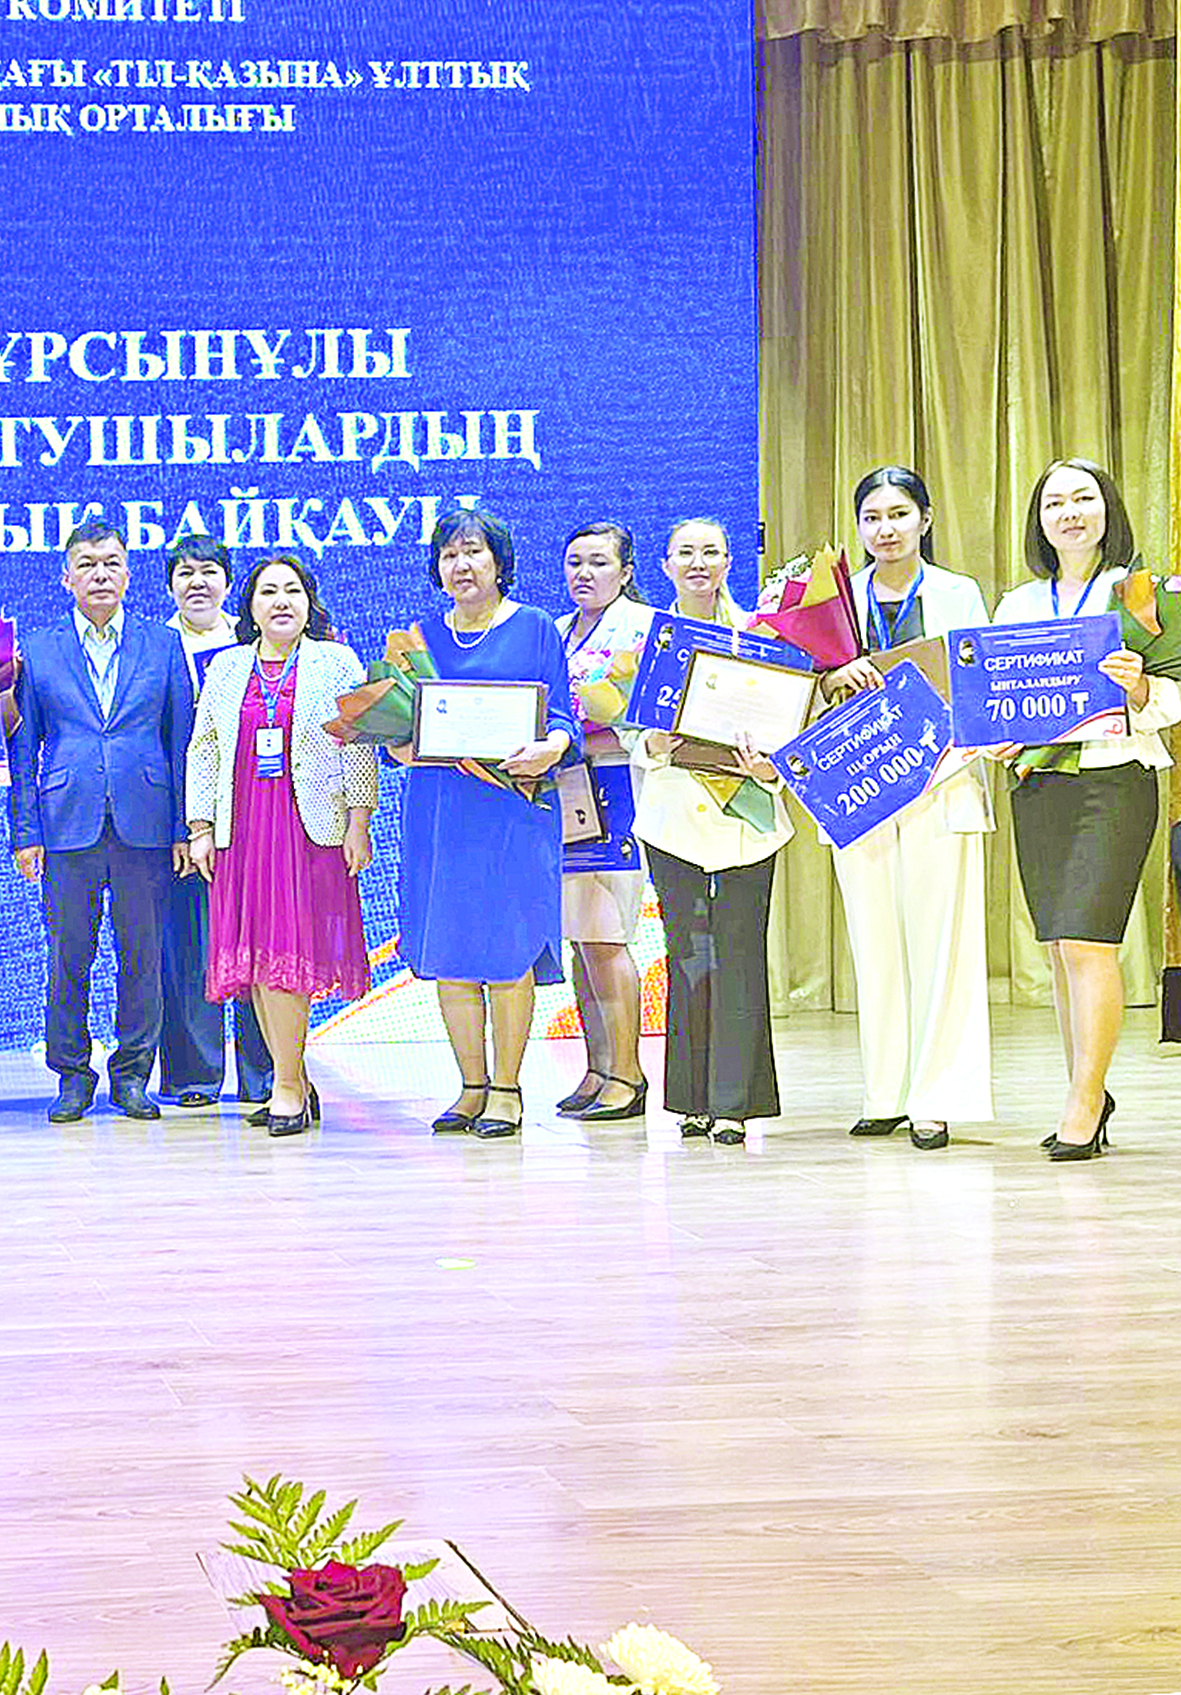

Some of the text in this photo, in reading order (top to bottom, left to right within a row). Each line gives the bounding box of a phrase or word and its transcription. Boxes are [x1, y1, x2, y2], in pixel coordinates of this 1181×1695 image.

[368, 61, 530, 92] ҰЛТТЫҚ
[79, 104, 296, 132] ОРТАЛЫҒЫ
[984, 649, 1085, 672] СЕРТИФИКАТ
[985, 697, 1017, 722] 70
[1022, 693, 1067, 719] 000
[817, 703, 904, 772] СЕРТИФИКАТ
[836, 776, 881, 816] 200
[878, 746, 925, 785] 000
